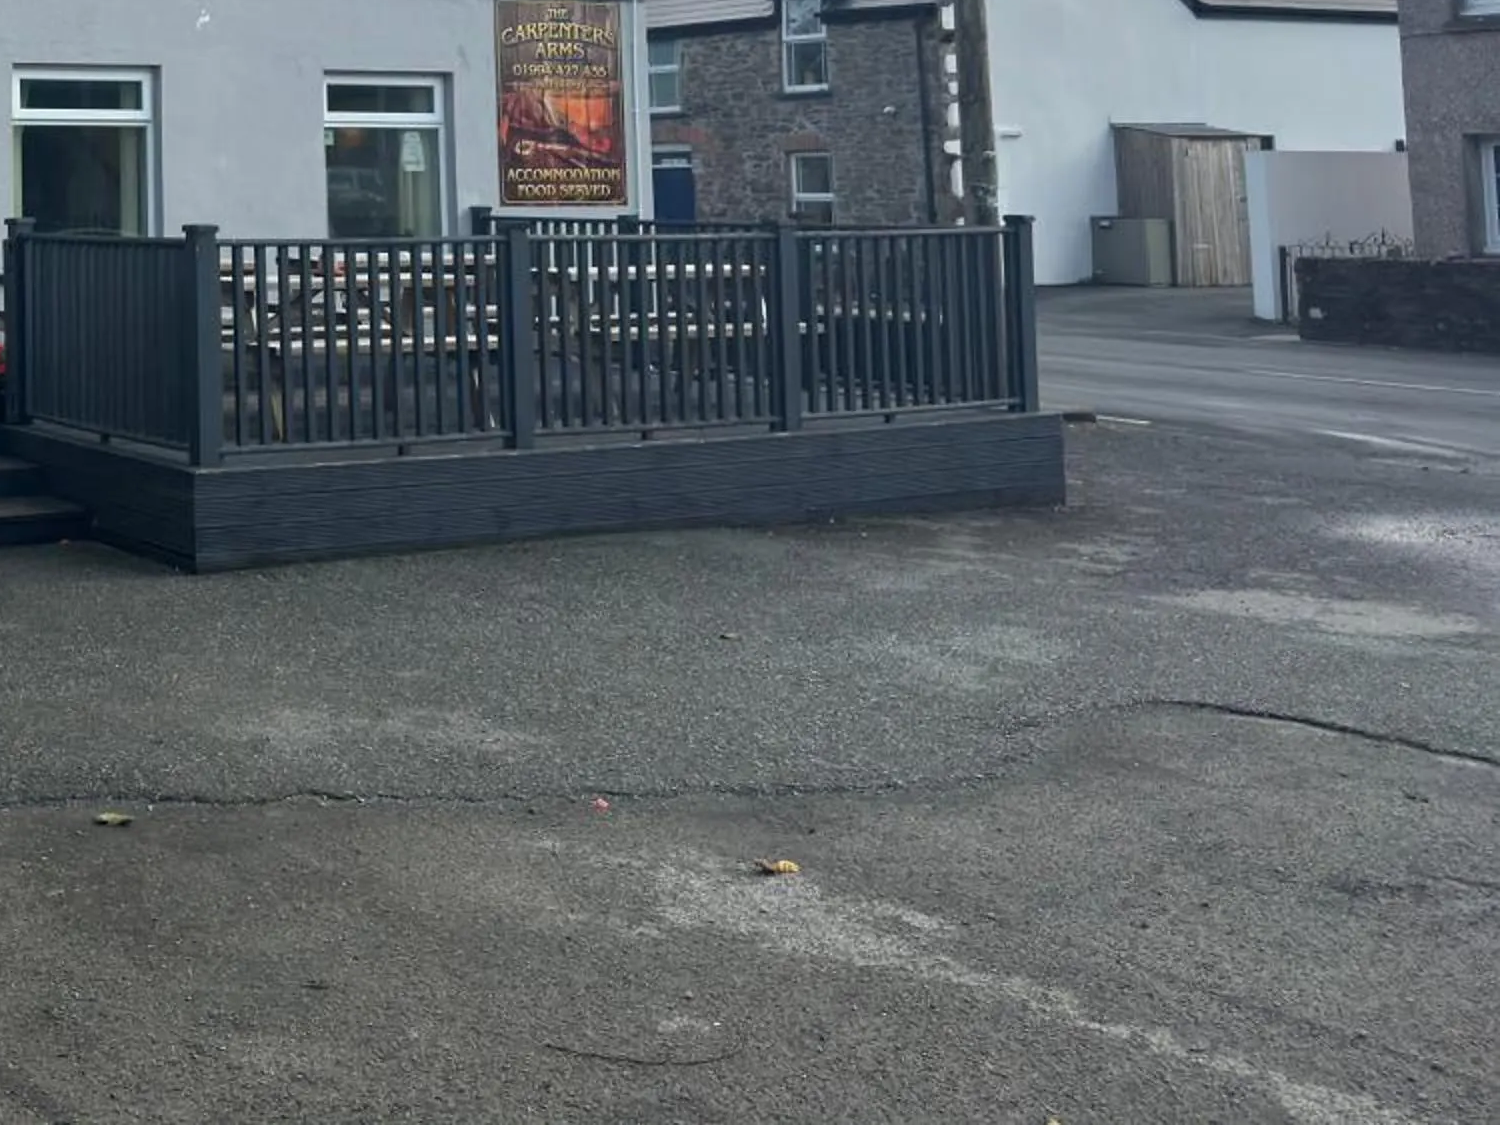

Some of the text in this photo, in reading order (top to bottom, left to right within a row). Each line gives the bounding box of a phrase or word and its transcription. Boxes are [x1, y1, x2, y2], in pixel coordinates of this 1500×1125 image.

[547, 8, 568, 19] THE
[501, 22, 614, 45] CARPENTERS
[535, 42, 585, 58] ARMS
[507, 168, 621, 181] ACCOMMODATION
[517, 184, 611, 196] FOOD SERVED
